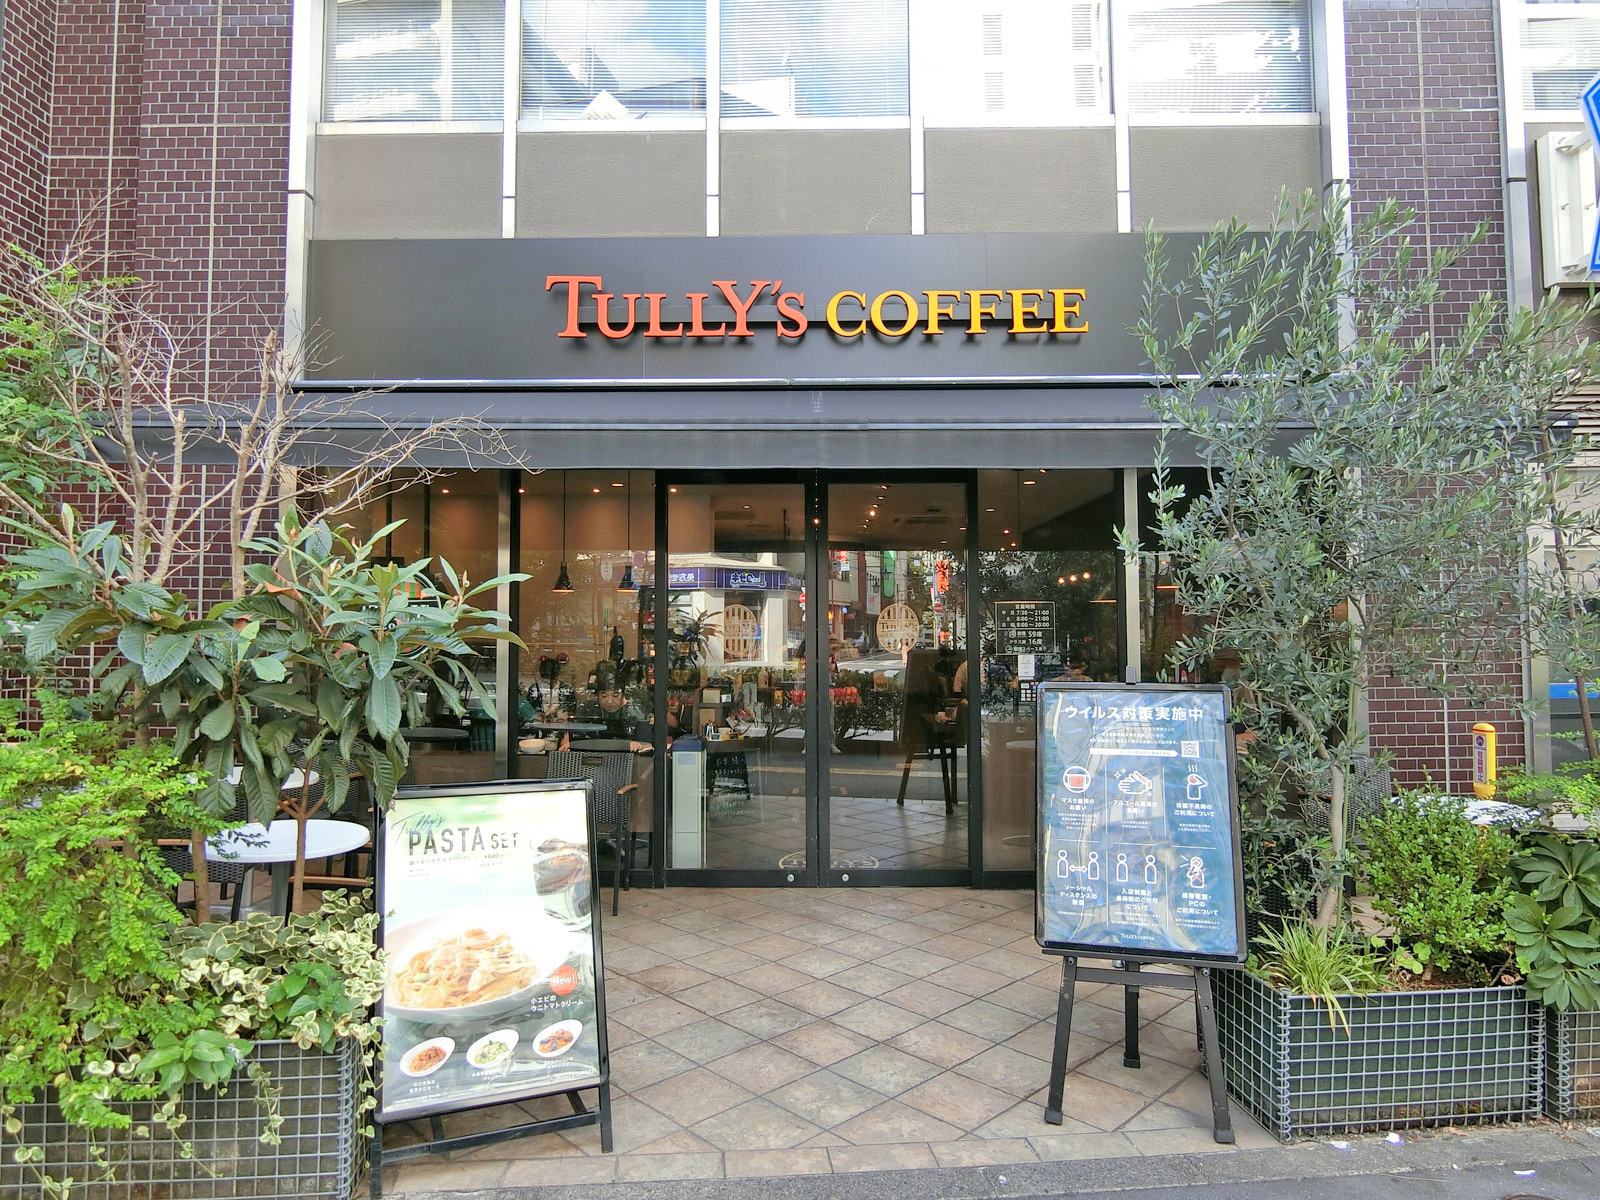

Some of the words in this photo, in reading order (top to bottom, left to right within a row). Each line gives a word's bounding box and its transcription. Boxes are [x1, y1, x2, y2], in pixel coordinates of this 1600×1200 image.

[544, 274, 808, 339] TULLY'S
[825, 288, 1089, 338] COFFEE
[1064, 705, 1204, 722] ウイルス対策実施中
[408, 826, 486, 856] PASTA
[490, 832, 519, 849] SET
[530, 994, 557, 1005] 小エビの
[531, 998, 584, 1013] ウニトマトクリーム
